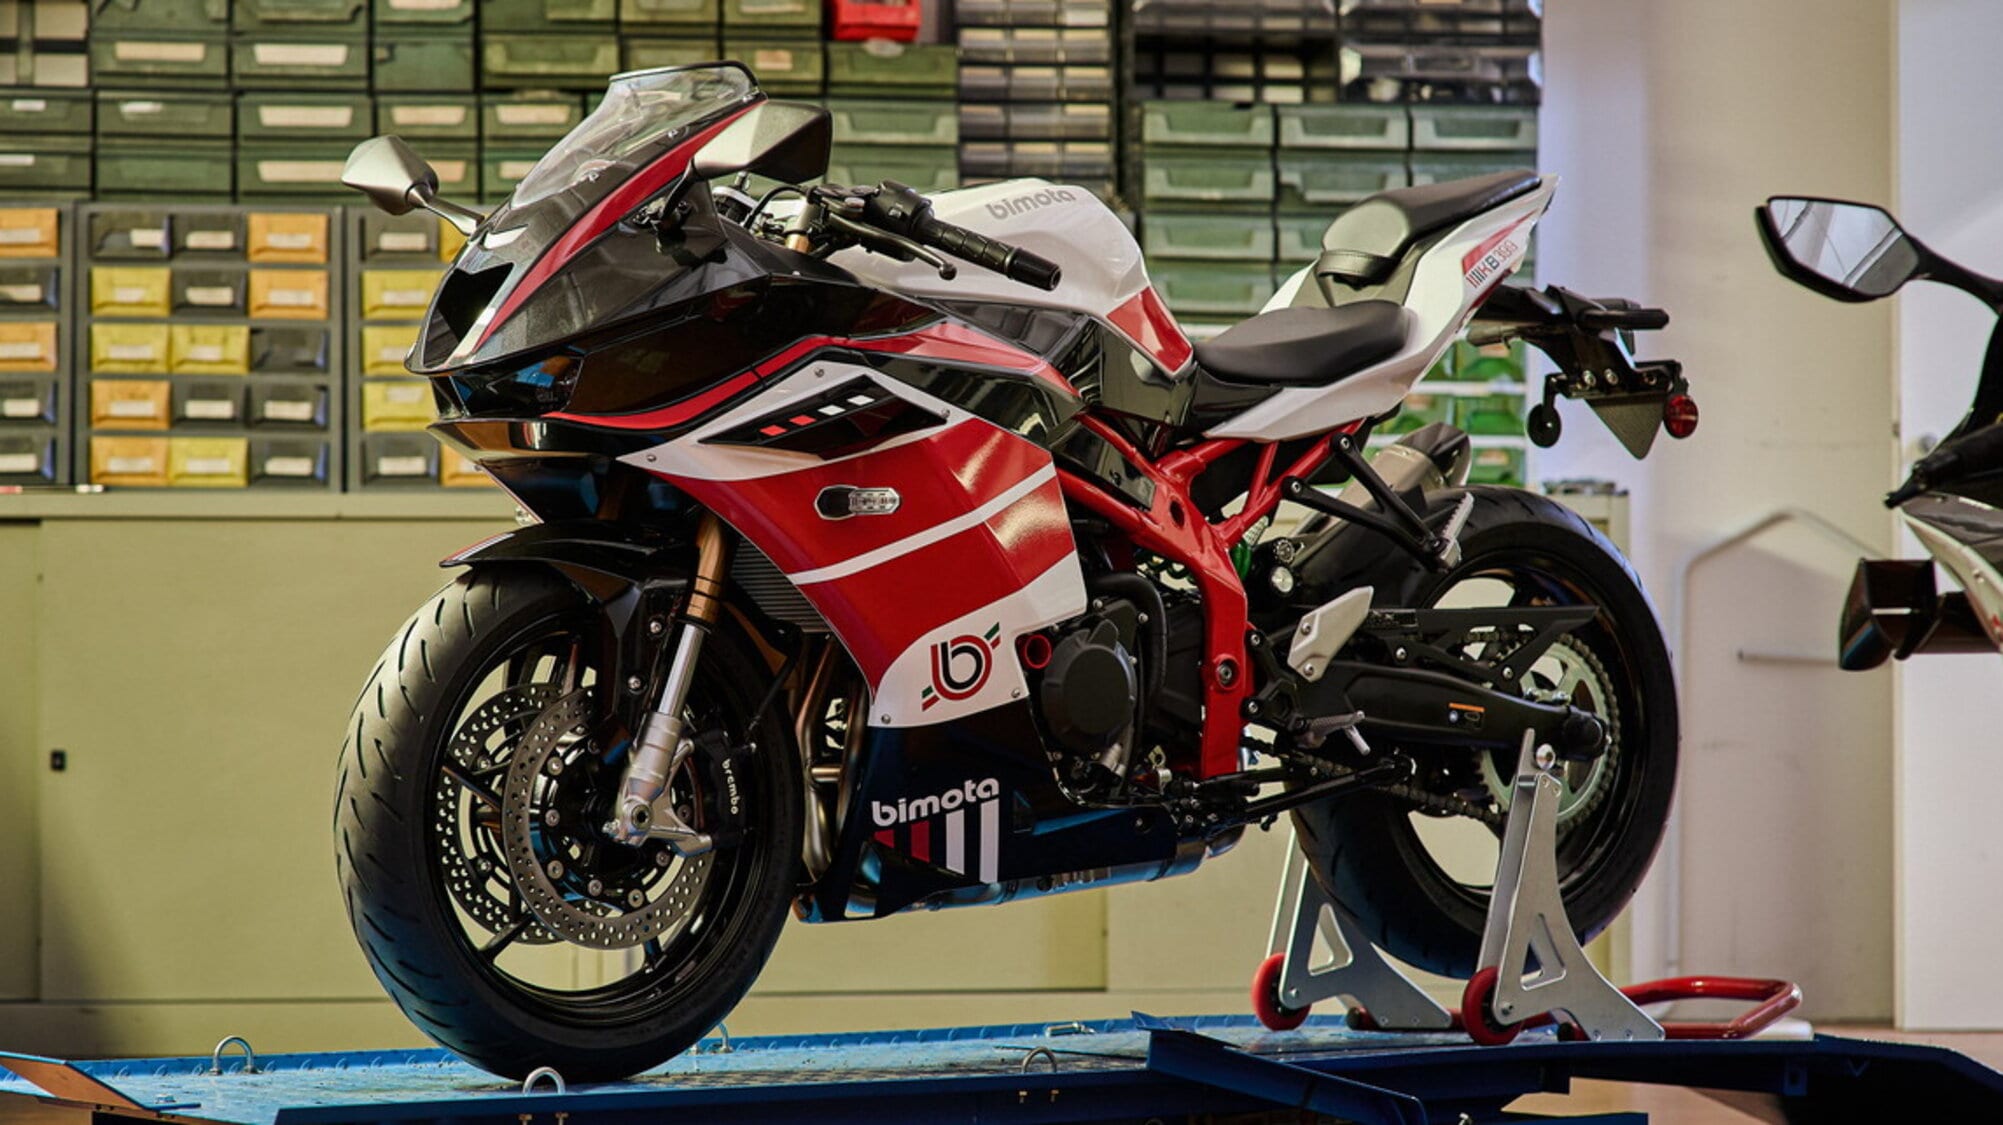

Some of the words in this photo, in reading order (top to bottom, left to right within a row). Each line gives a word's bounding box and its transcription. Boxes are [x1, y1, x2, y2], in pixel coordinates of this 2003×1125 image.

[985, 188, 1077, 220] bimota
[722, 758, 740, 815] brembo
[872, 778, 999, 827] bimota
